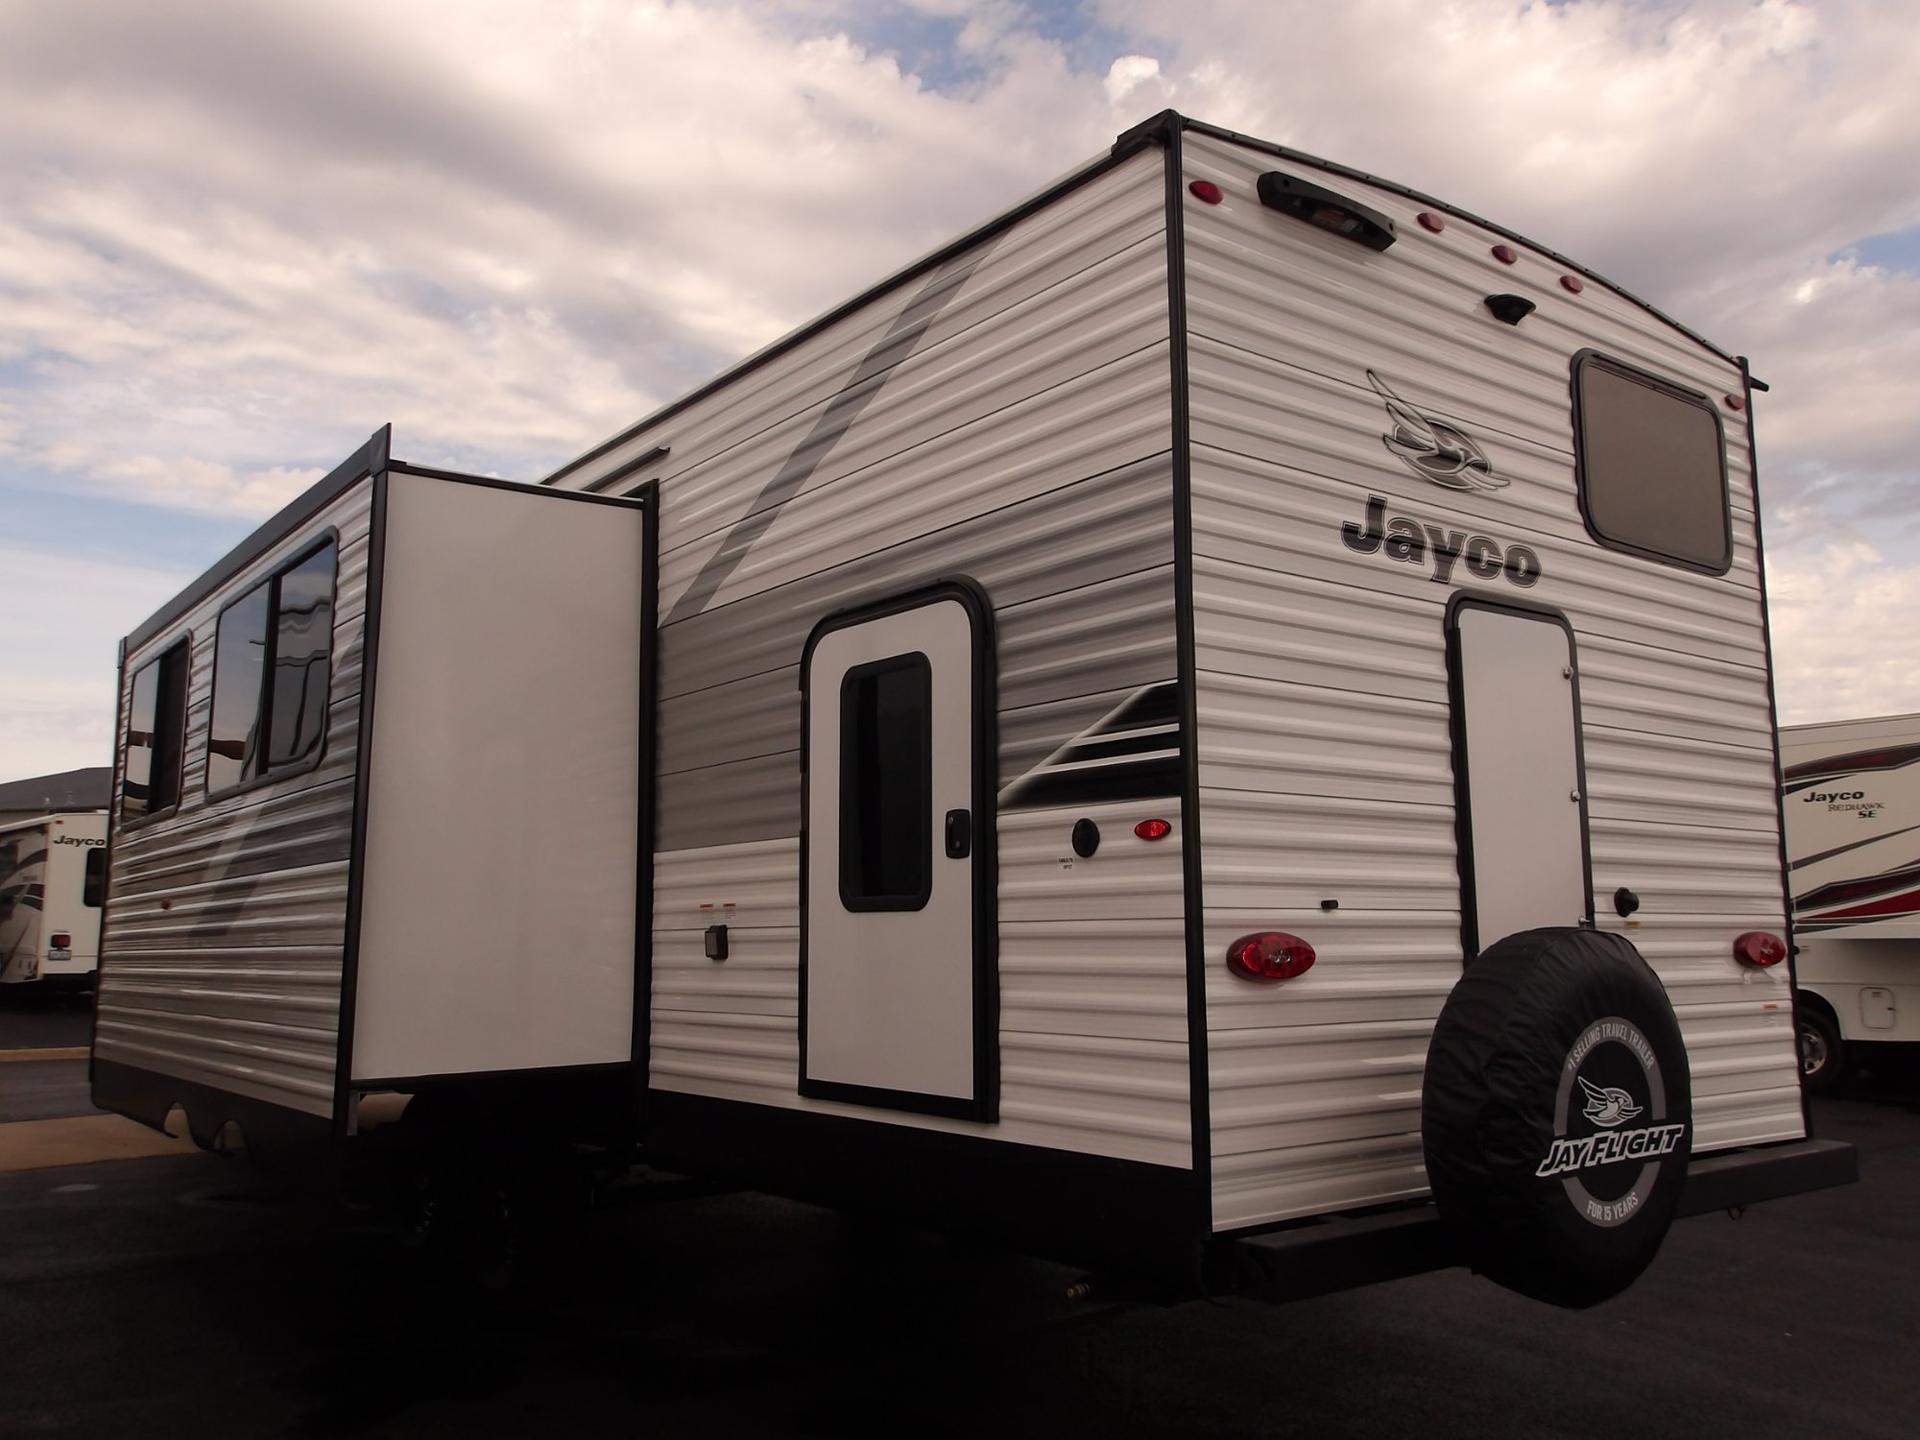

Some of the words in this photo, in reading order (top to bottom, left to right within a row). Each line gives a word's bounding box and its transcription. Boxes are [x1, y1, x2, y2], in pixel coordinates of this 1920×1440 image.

[1341, 493, 1542, 588] Jayco
[1803, 791, 1865, 803] Jayco
[1828, 802, 1885, 812] REDHAWK
[1858, 810, 1877, 819] SE
[53, 835, 106, 847] Jayco
[1573, 1026, 1601, 1062] SELLING
[1601, 1023, 1628, 1040] TRAVEL
[1628, 1029, 1655, 1070] TRAILER
[1587, 1200, 1603, 1220] FOR
[1612, 1191, 1639, 1219] YEARS
